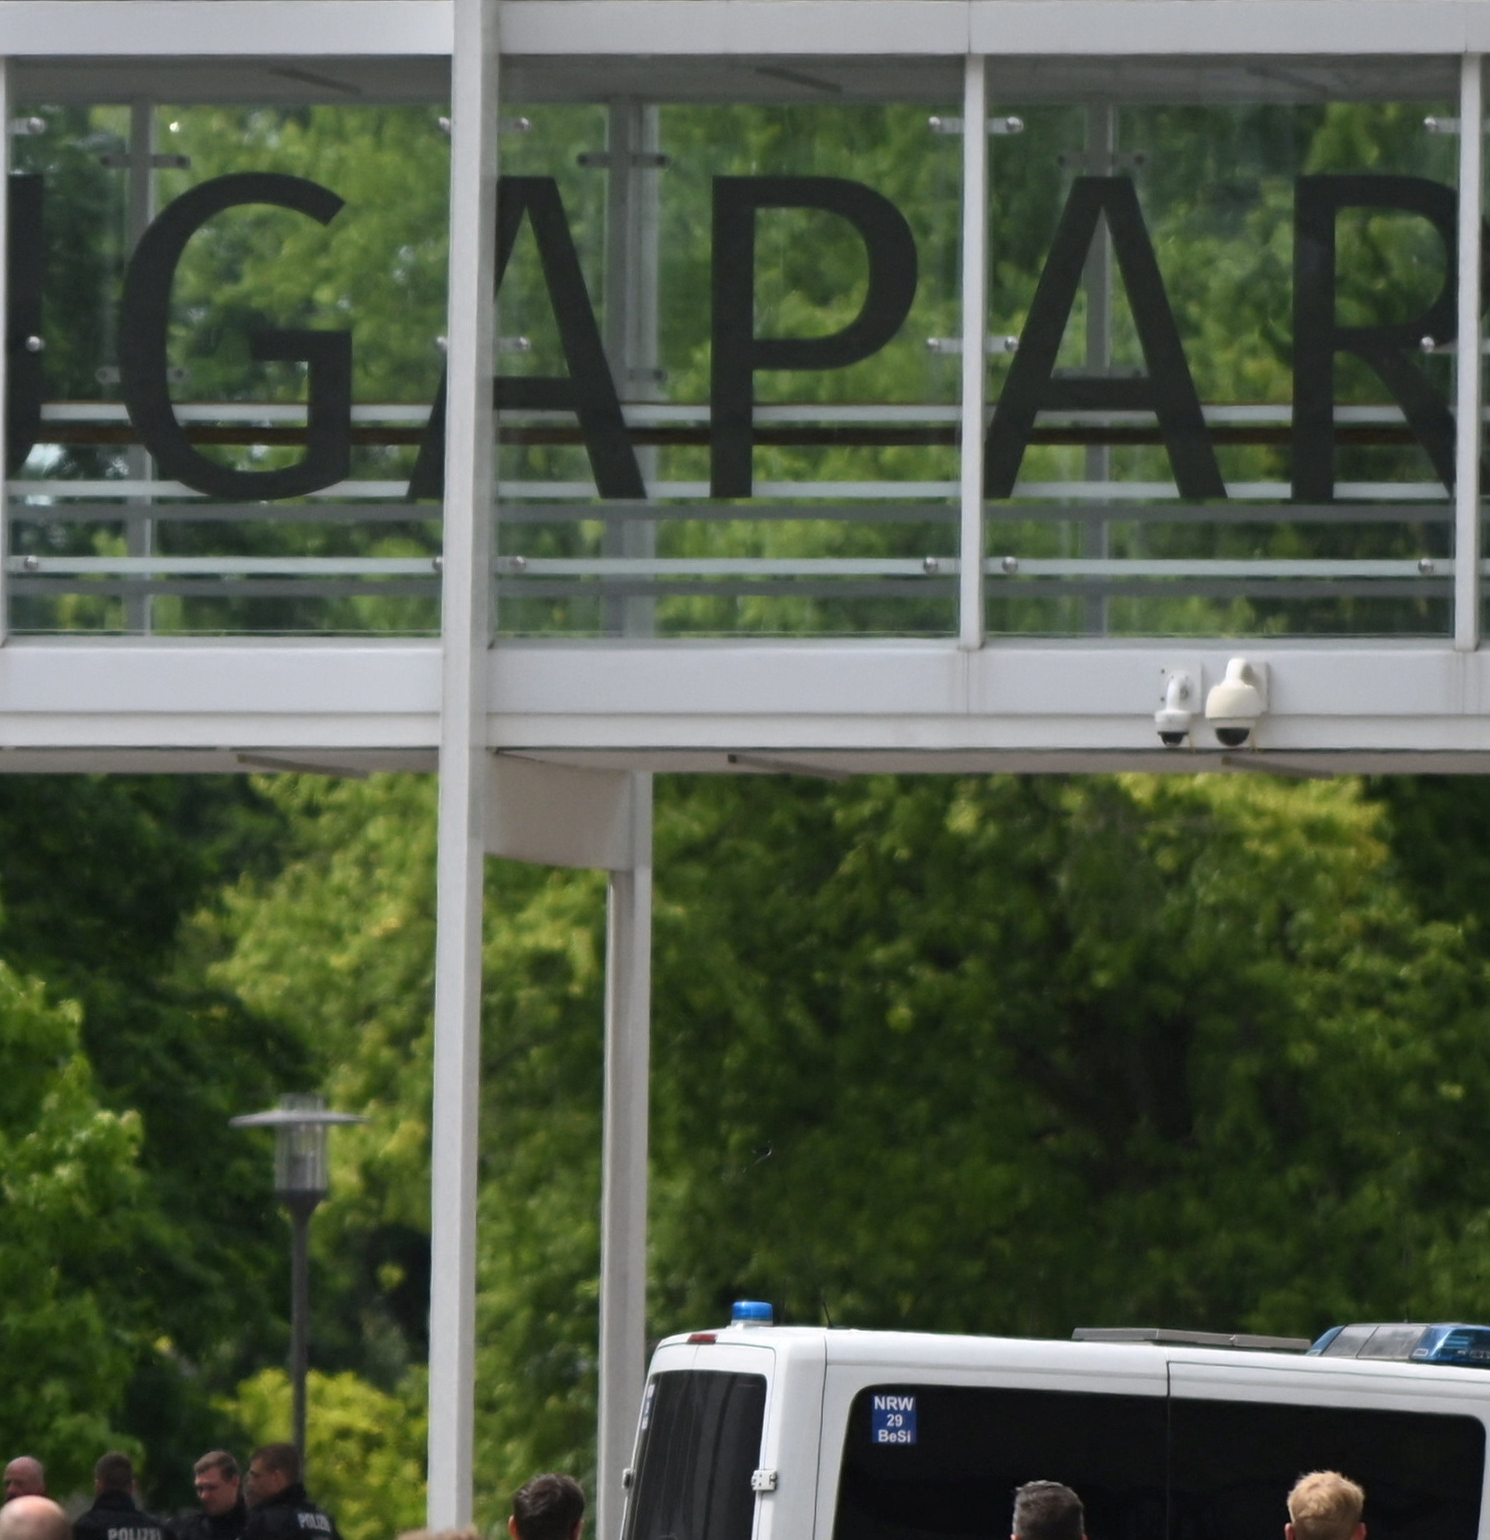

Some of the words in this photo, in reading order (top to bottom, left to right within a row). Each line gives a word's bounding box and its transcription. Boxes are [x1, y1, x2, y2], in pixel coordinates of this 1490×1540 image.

[874, 1395, 914, 1411] NRW
[886, 1413, 903, 1427] 29
[878, 1429, 911, 1443] BeSi
